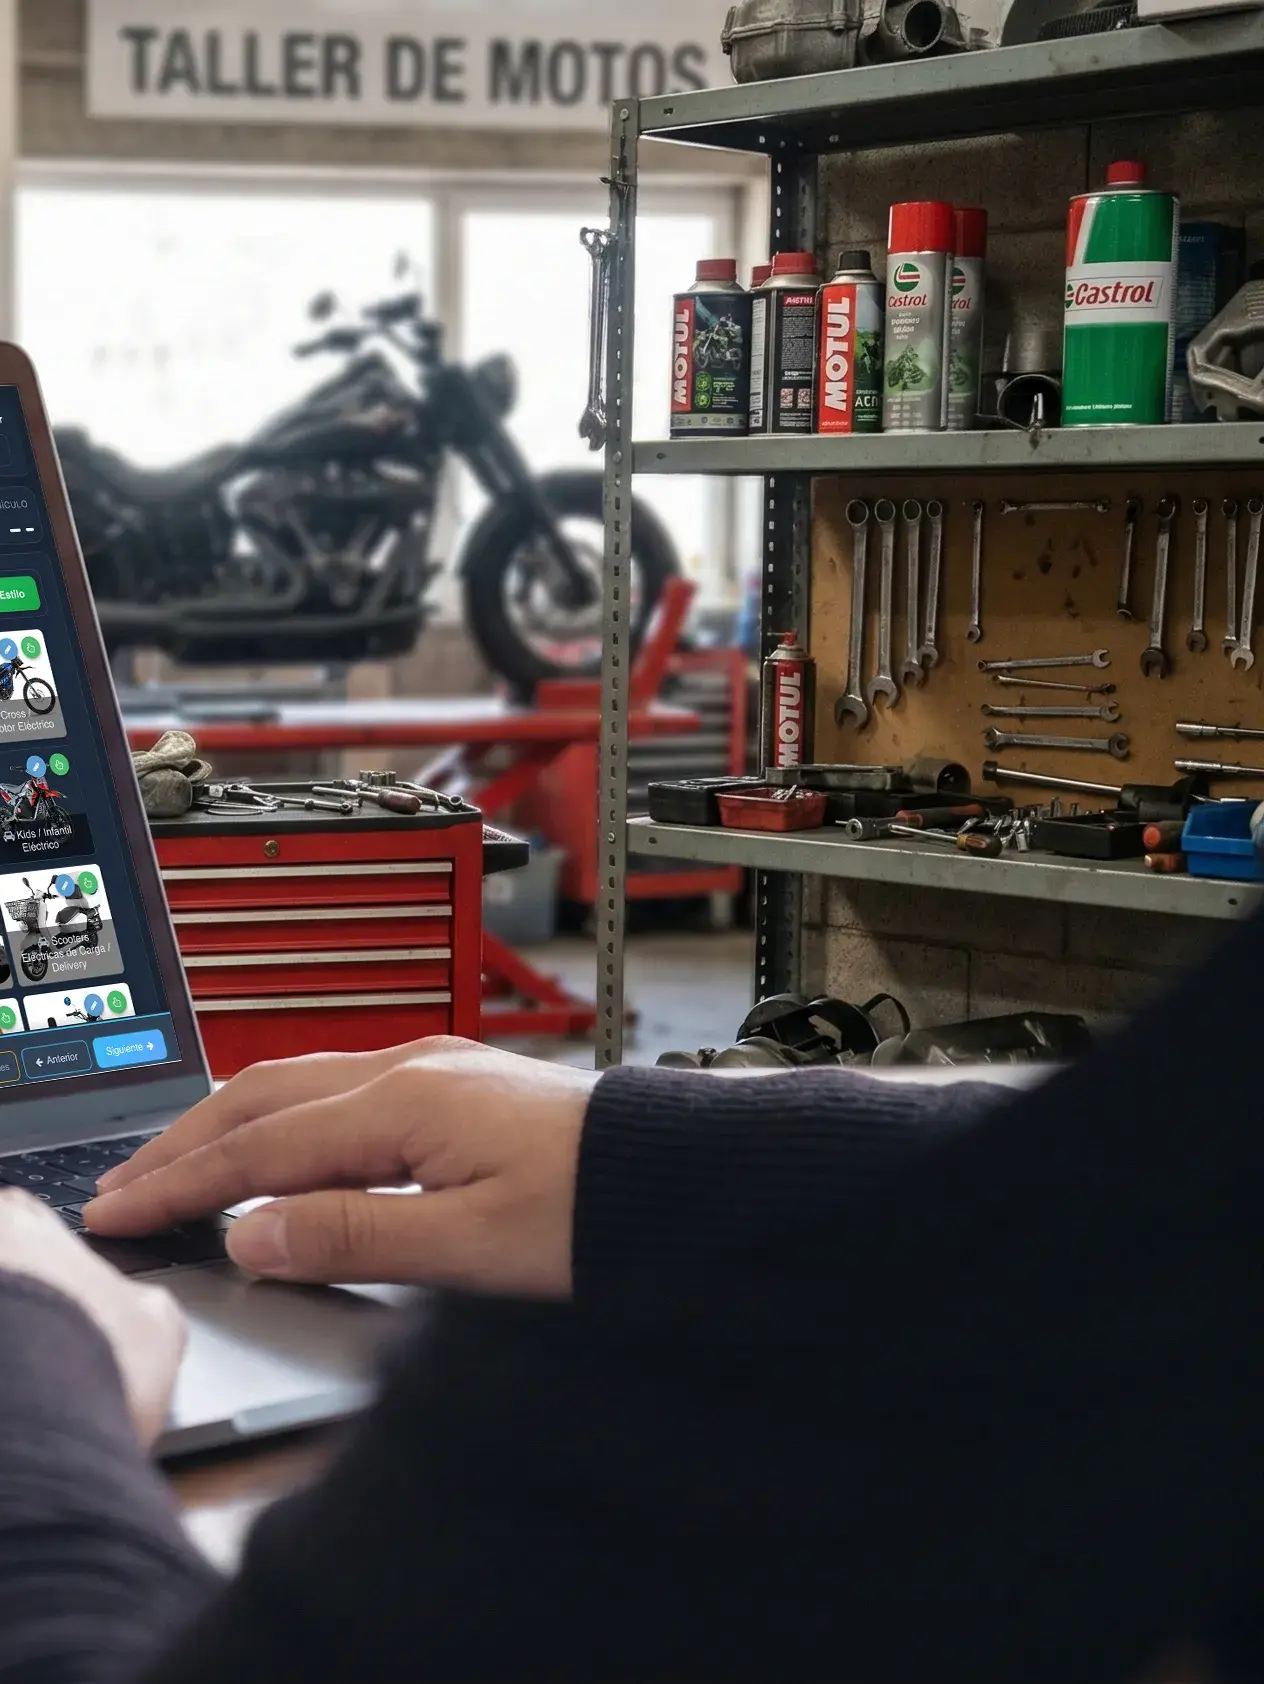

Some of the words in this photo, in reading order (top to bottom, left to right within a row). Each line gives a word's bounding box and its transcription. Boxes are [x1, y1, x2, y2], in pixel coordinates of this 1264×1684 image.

[119, 26, 361, 99] TALLER
[385, 36, 465, 101] DE
[488, 40, 707, 106] MOTOS
[1074, 281, 1154, 306] Castrol
[673, 309, 690, 405] MOTUL
[824, 297, 850, 412] MOTUL
[1, 710, 26, 720] Cross
[778, 672, 801, 768] MOTUL
[18, 720, 55, 732] Eléctrico
[17, 829, 36, 840] Kids
[43, 825, 72, 836] Infantil
[23, 841, 60, 853] Eléctrico
[51, 933, 89, 946] Scooters
[79, 945, 106, 958] Carga
[52, 959, 87, 973] Delivery
[106, 1042, 143, 1057] Siguiente
[46, 1052, 78, 1065] Anterior
